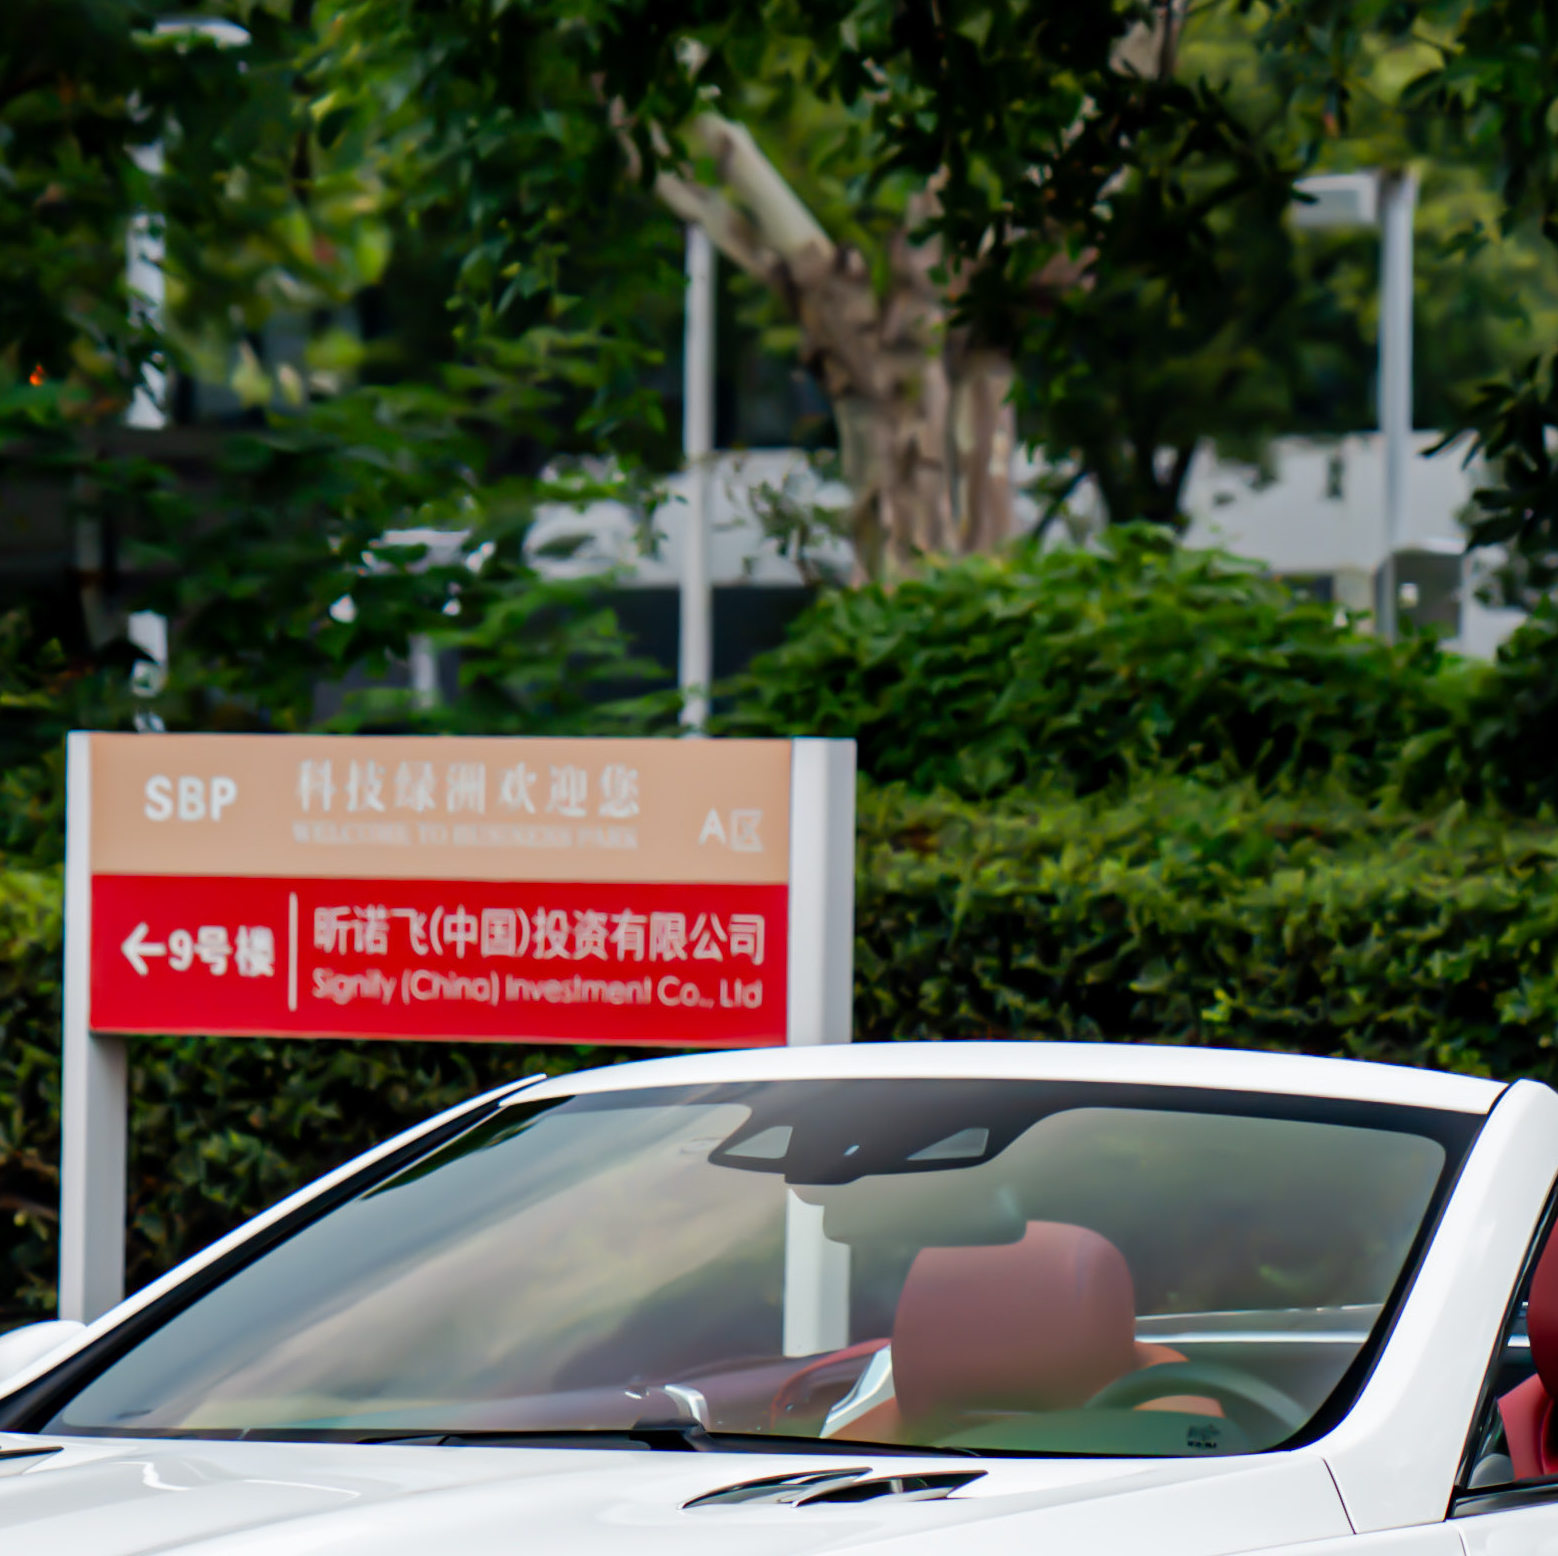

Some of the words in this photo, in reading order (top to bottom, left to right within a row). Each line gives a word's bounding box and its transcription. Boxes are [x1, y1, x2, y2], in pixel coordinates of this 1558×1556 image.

[145, 775, 237, 822] SBP
[297, 759, 640, 818] 科技绿洲欢迎您
[168, 925, 275, 977] 9号楼
[312, 967, 397, 1005] Signify
[401, 968, 500, 1006] (China)
[505, 973, 652, 1005] Investment
